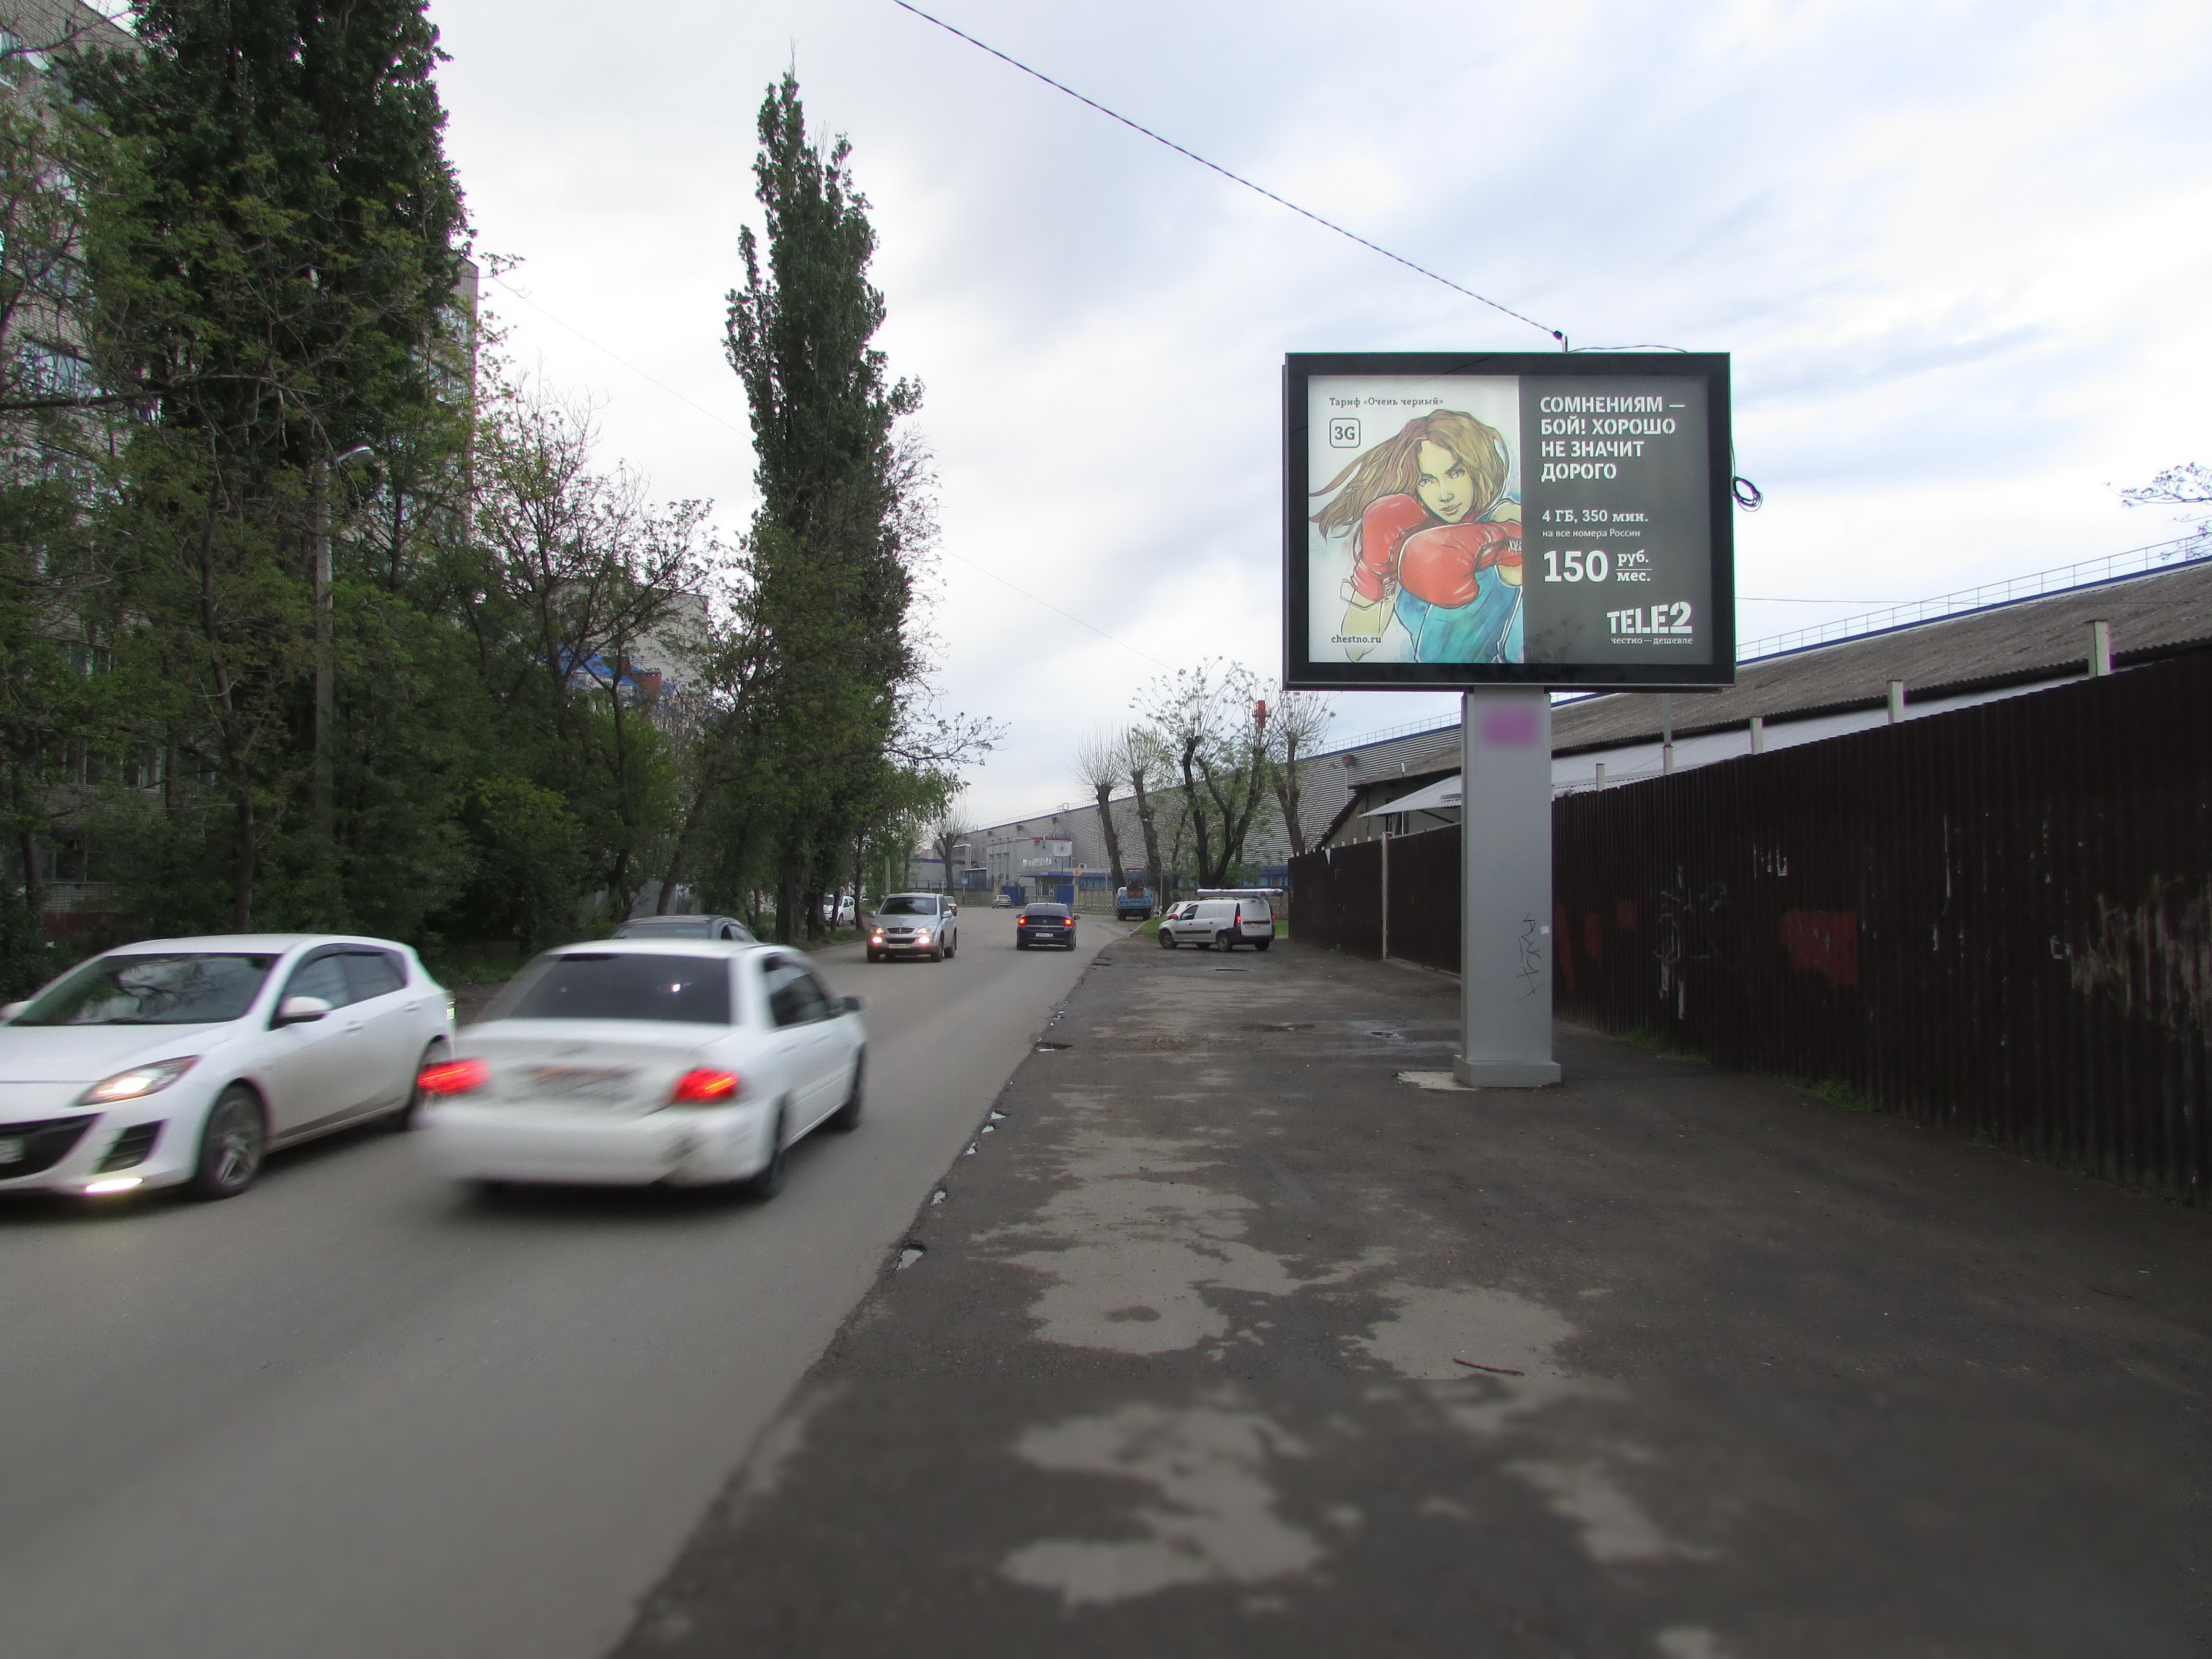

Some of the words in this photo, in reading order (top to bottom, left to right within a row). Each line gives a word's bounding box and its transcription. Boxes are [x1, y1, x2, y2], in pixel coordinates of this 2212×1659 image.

[1329, 397, 1360, 408] Тариф
[1364, 397, 1397, 406] «Очень
[1401, 397, 1443, 407] черный»
[1540, 397, 1663, 413] СОМНЕНИЯМ
[1334, 426, 1355, 440] 3G
[1541, 416, 1586, 435] БОЙ!
[1591, 418, 1675, 435] ХОРОШО
[1541, 441, 1566, 457] НЕ
[1571, 441, 1644, 457] ЗНАЧИТ
[1540, 463, 1617, 482] ДОРОГО
[1541, 510, 1551, 522] 4
[1555, 510, 1578, 524] ГБ,
[1582, 510, 1608, 522] 350
[1612, 512, 1648, 523] мин.
[1573, 530, 1607, 539] номера
[1610, 529, 1640, 538] России
[1543, 550, 1608, 582] 150
[1617, 550, 1649, 567] руб.
[1616, 572, 1650, 582] мес.
[1606, 601, 1693, 634] TELE2
[1331, 635, 1382, 643] chestno.ru
